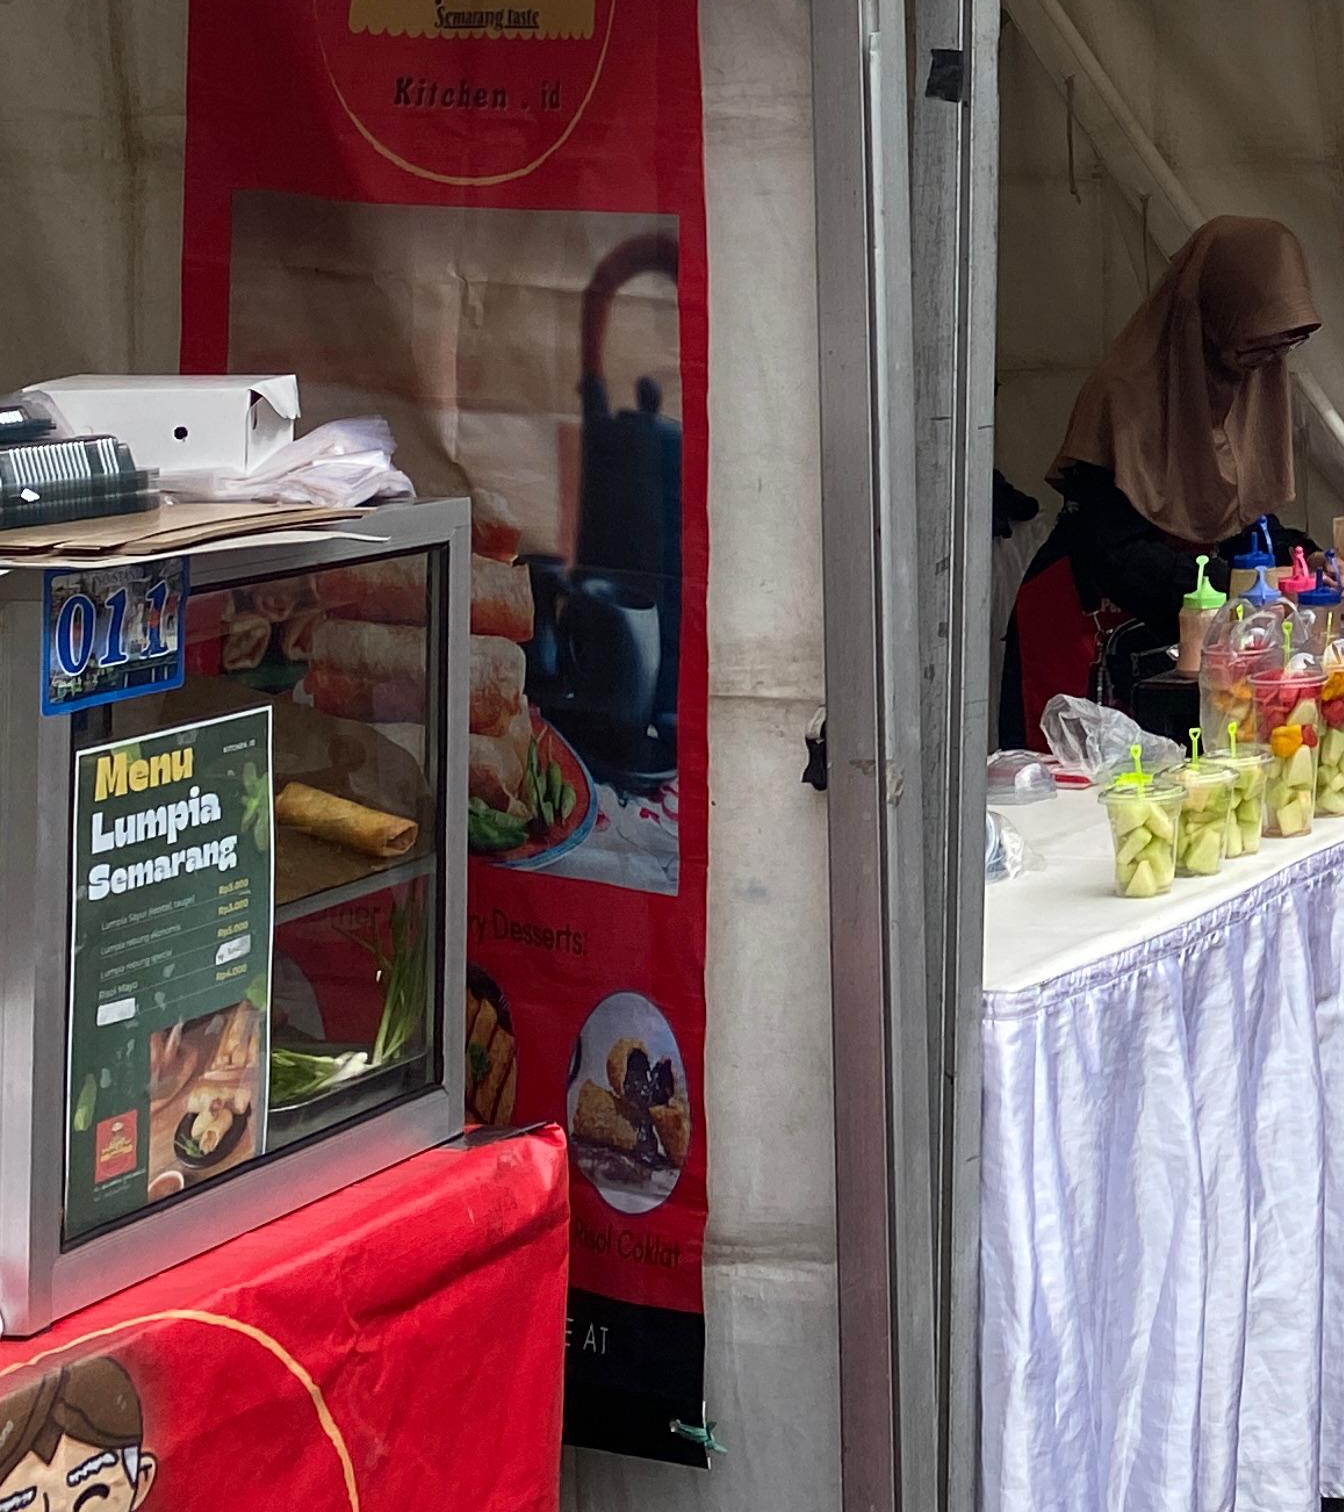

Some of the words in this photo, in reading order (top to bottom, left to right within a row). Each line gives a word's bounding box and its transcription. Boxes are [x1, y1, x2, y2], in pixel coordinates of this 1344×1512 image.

[434, 5, 504, 31] Semarang
[506, 8, 540, 29] taste
[393, 77, 508, 109] Kitchen
[540, 80, 562, 110] id
[56, 580, 170, 677] 011
[94, 747, 194, 802] Menu
[91, 785, 222, 855] Lumpia
[88, 834, 238, 901] Semarang
[492, 908, 589, 956] Desserts:
[617, 1229, 682, 1270] Coklat
[582, 1322, 609, 1355] AT
